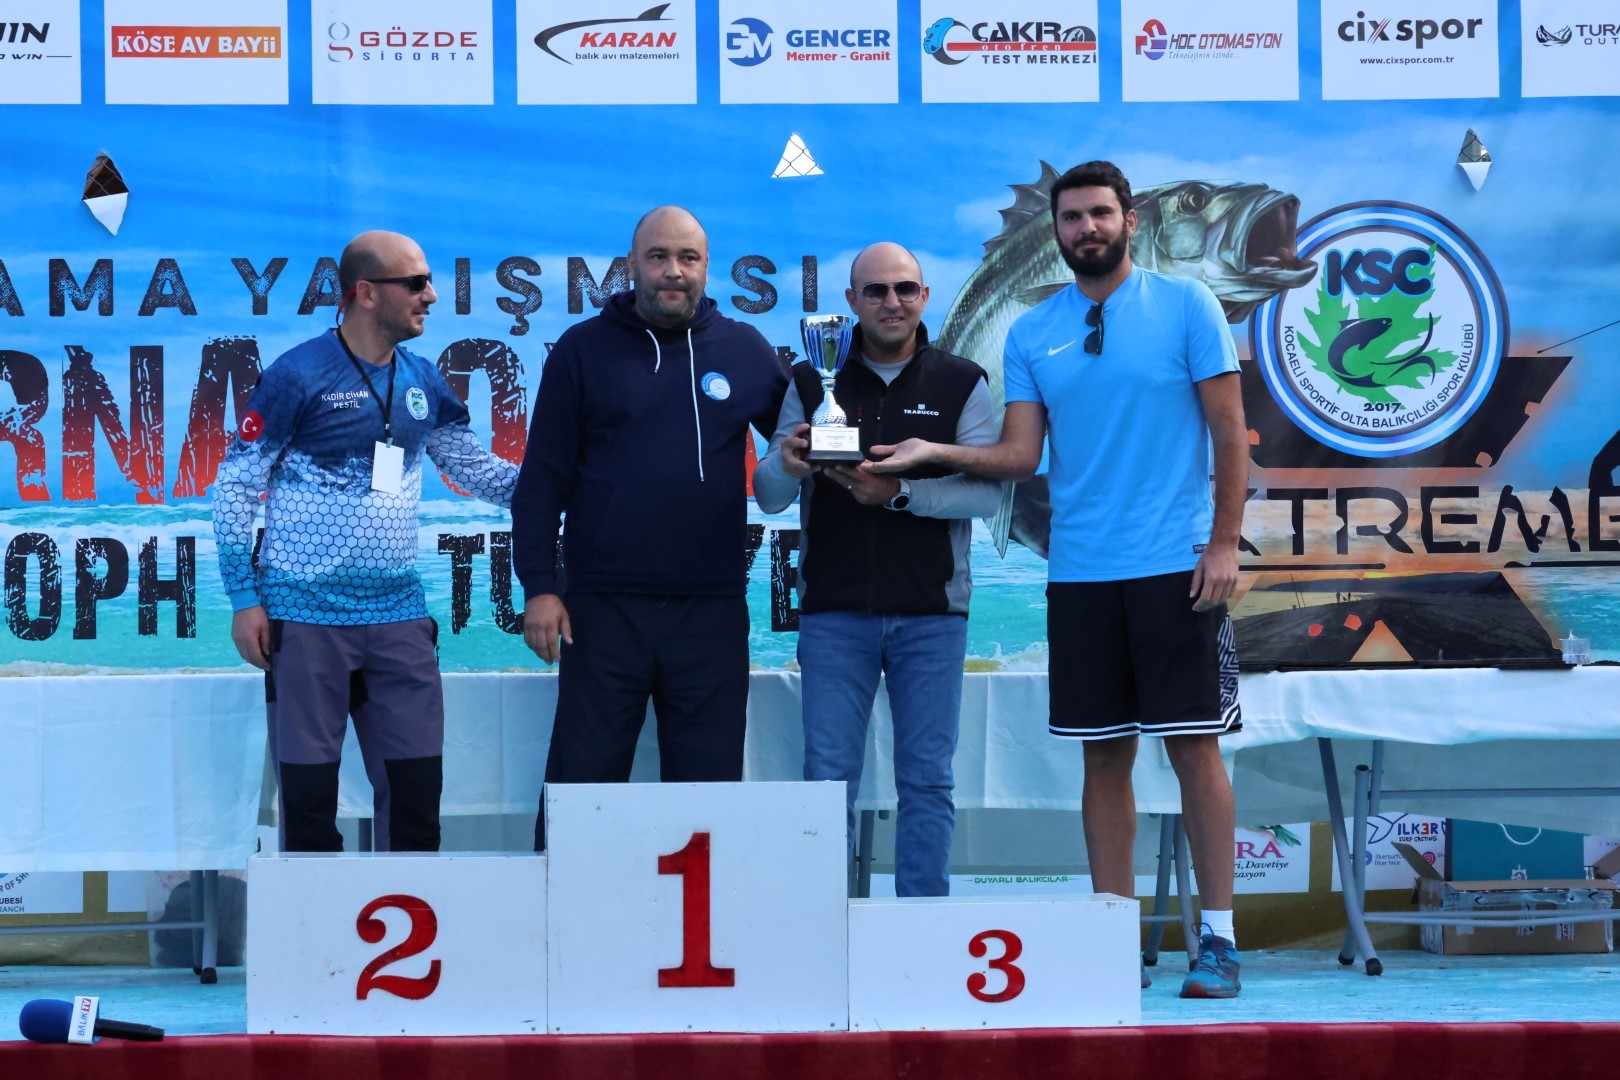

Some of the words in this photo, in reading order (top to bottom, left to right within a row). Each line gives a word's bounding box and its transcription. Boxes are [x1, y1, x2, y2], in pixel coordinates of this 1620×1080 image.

[117, 30, 175, 53] KÖSE
[181, 37, 210, 53] AV
[360, 27, 477, 47] GÖZDE
[580, 32, 677, 48] KARAN
[786, 29, 890, 48] GENCER
[1198, 33, 1282, 50] OTOMASYON
[362, 50, 474, 61] SİGORTA
[619, 52, 680, 60] malzemeleri
[786, 52, 838, 62] Mermer
[850, 51, 891, 62] Granit
[982, 54, 1021, 64] TEST
[1027, 52, 1097, 64] MERKEZİ
[1360, 55, 1454, 65] www.cixspor.com.tr
[1326, 248, 1433, 297] KSC
[1284, 325, 1307, 378] KOCAELİ
[1299, 377, 1341, 415] SPORTİF
[1340, 411, 1369, 427] OLTA
[1372, 399, 1439, 428] BALIKÇILIĞI
[1437, 373, 1463, 402] SPOR
[1457, 323, 1474, 373] KULÜBÜ
[1363, 402, 1402, 414] 2017
[1245, 860, 1289, 871] Davetiye
[974, 876, 1013, 884] DUYARLI
[658, 832, 735, 988] 1
[356, 894, 441, 1001] 2
[966, 929, 1026, 1004] 3
